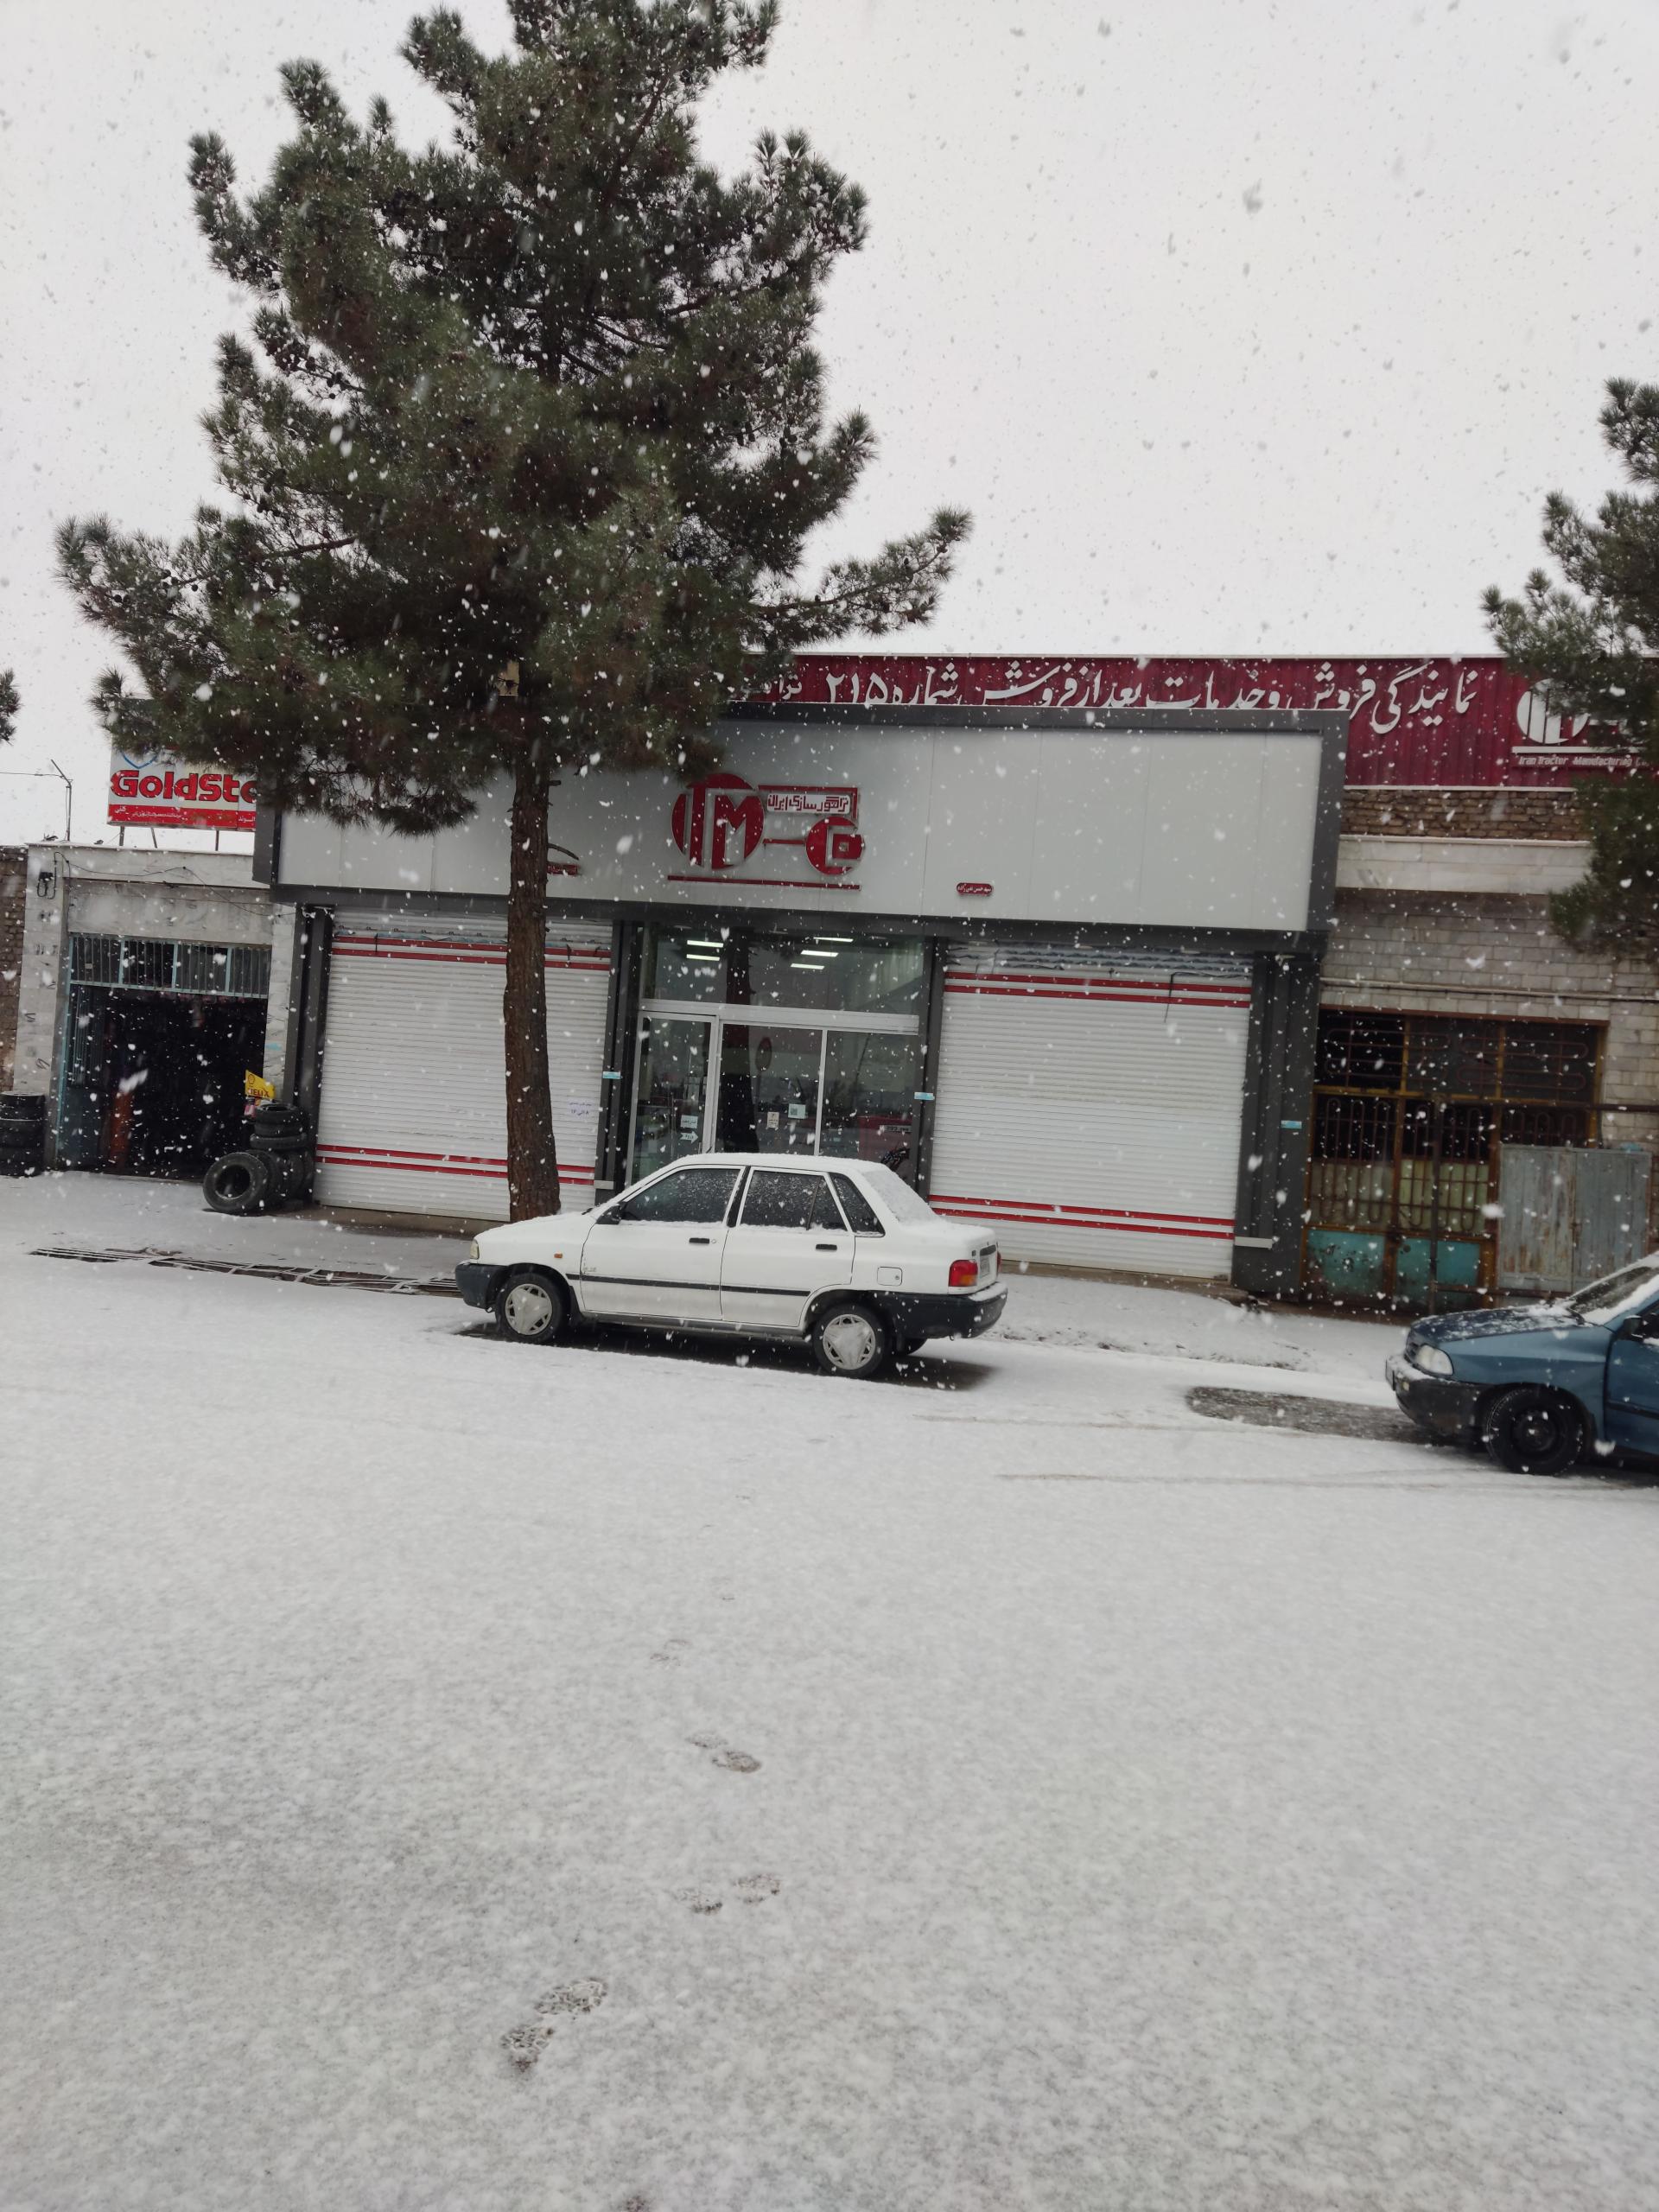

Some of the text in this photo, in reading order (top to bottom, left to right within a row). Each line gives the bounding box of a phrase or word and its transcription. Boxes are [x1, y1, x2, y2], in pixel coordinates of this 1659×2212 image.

[826, 671, 889, 704] ۲۱۵
[891, 662, 960, 706] شماره
[1286, 661, 1376, 720] فروش
[1370, 660, 1478, 734] نمایندگی
[1518, 756, 1536, 766] Iran
[1538, 757, 1568, 766] Tractor
[1572, 755, 1633, 767] Manufacturing
